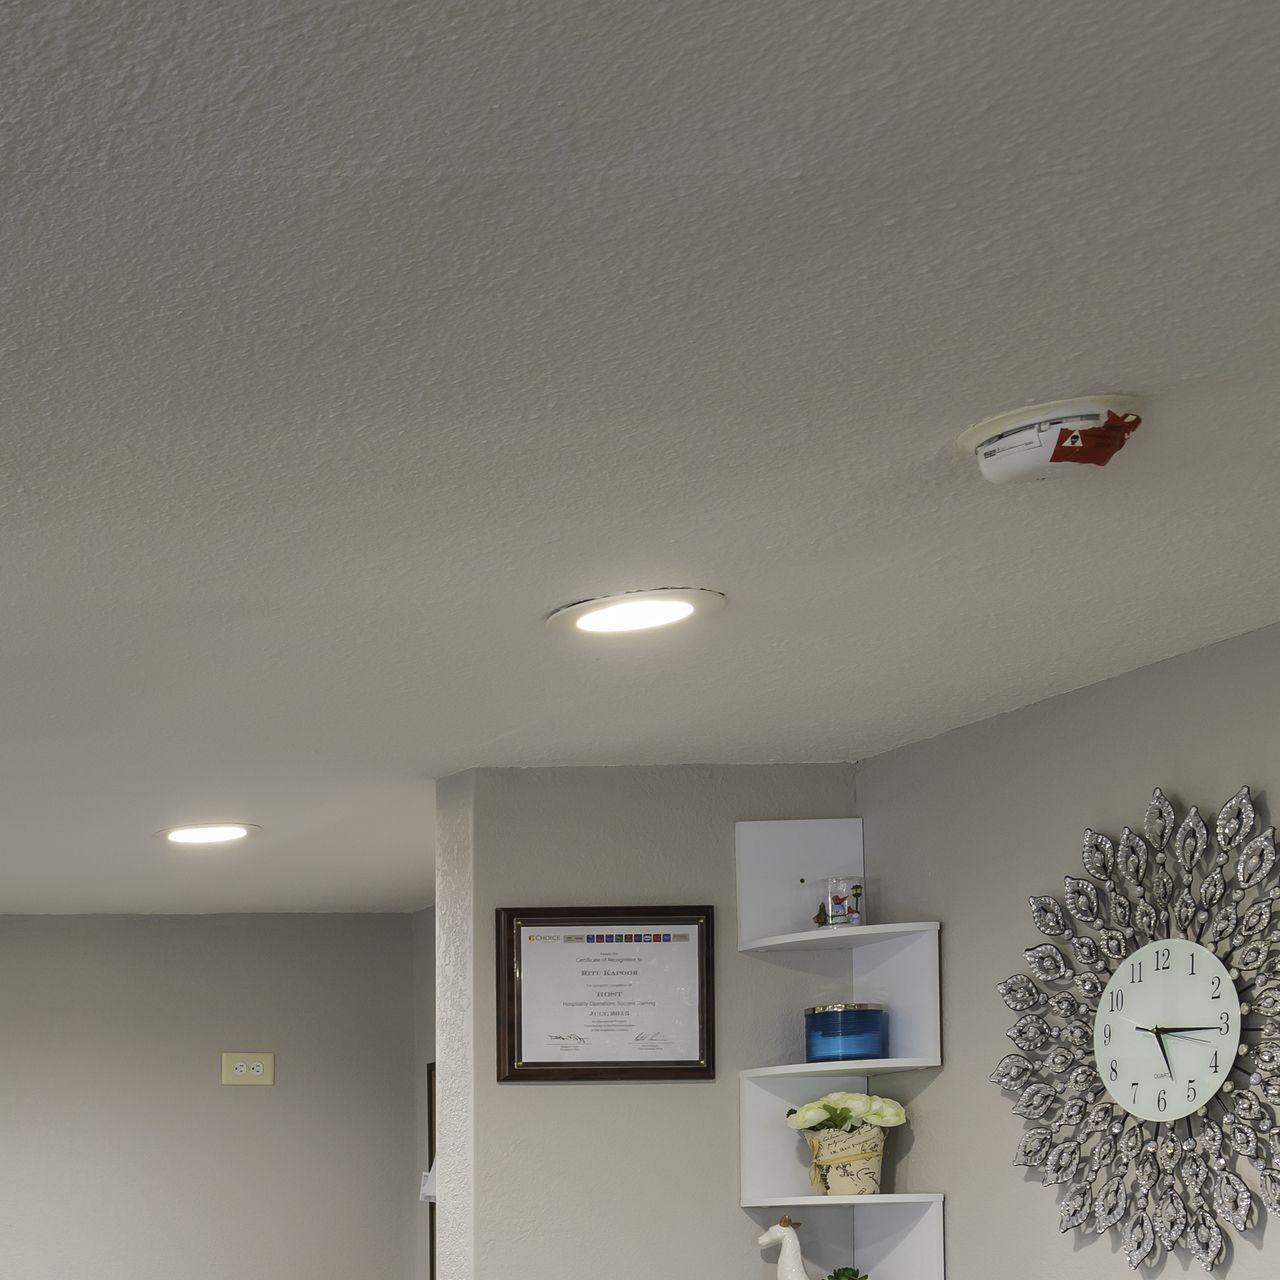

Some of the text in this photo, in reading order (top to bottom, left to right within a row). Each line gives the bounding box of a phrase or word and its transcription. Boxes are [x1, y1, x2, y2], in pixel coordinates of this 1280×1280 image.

[1154, 948, 1171, 972] 12
[1188, 952, 1196, 976] 1
[1130, 962, 1143, 984] 11
[1211, 976, 1221, 1000] 2
[1109, 989, 1124, 1012] 10
[1103, 1024, 1111, 1046] 9
[1219, 1012, 1230, 1035] 3
[1110, 1060, 1118, 1082] 8
[1209, 1050, 1219, 1073] 4
[1131, 1082, 1139, 1104] 7
[1157, 1089, 1167, 1112] 6
[1187, 1079, 1196, 1102] 5
